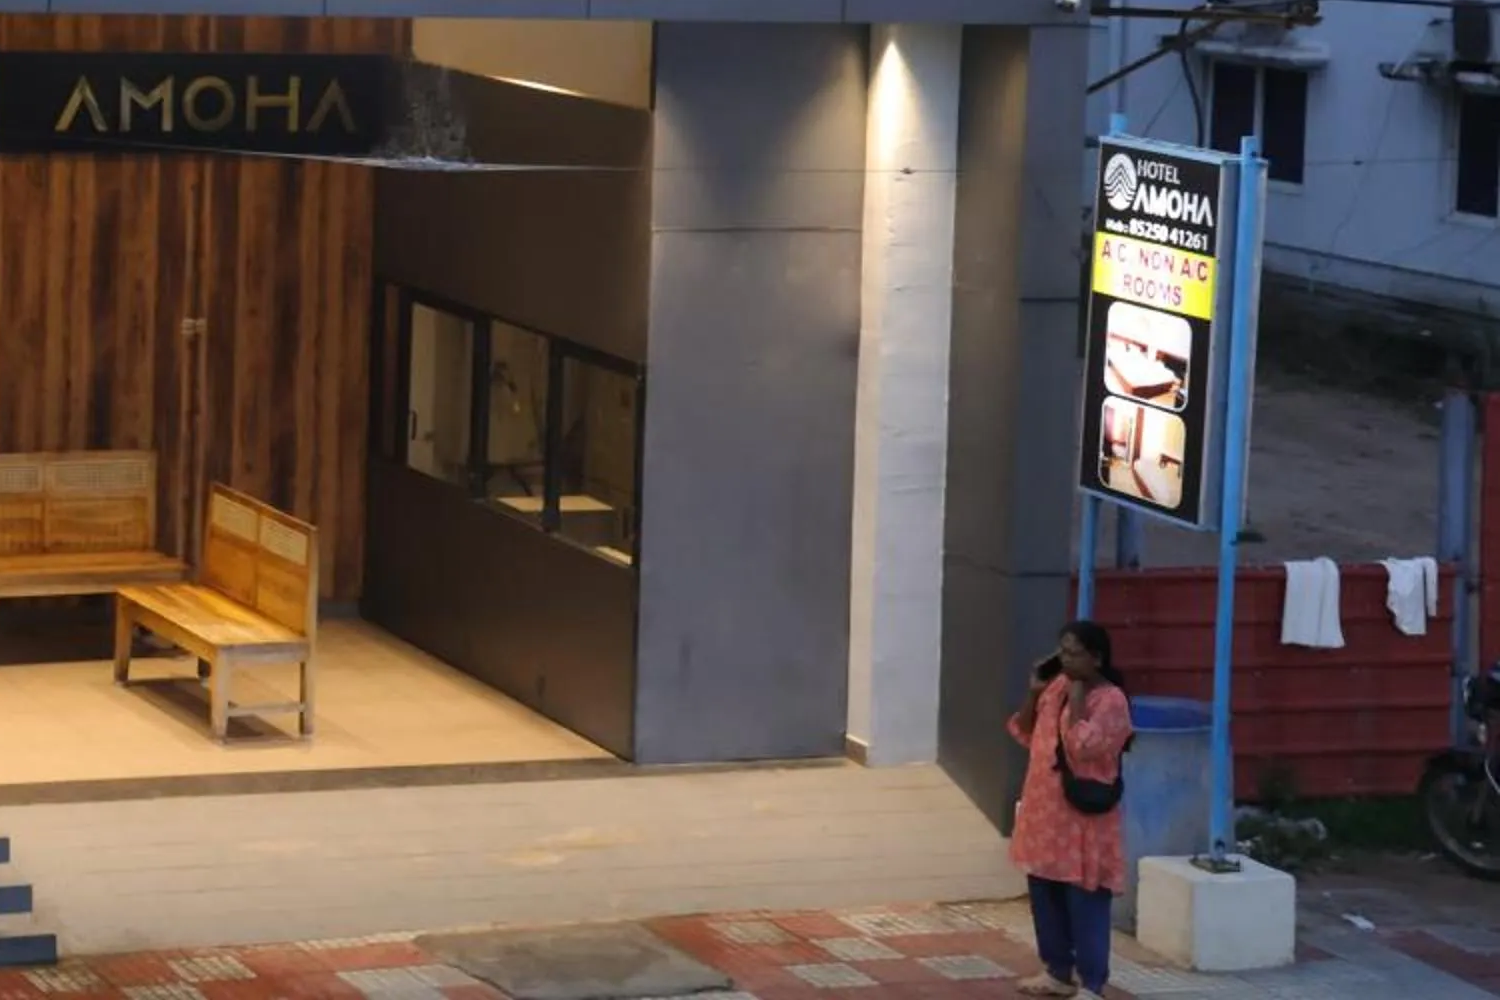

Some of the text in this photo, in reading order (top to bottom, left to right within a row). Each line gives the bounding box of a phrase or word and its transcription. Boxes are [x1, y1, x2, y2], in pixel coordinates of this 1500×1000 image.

[55, 75, 358, 133] AMOHA
[1137, 159, 1181, 185] HOTEL
[1132, 183, 1213, 227] AMOHA
[1169, 228, 1209, 251] 41261
[1139, 247, 1176, 273] NON
[1123, 274, 1182, 306] ROOMS
